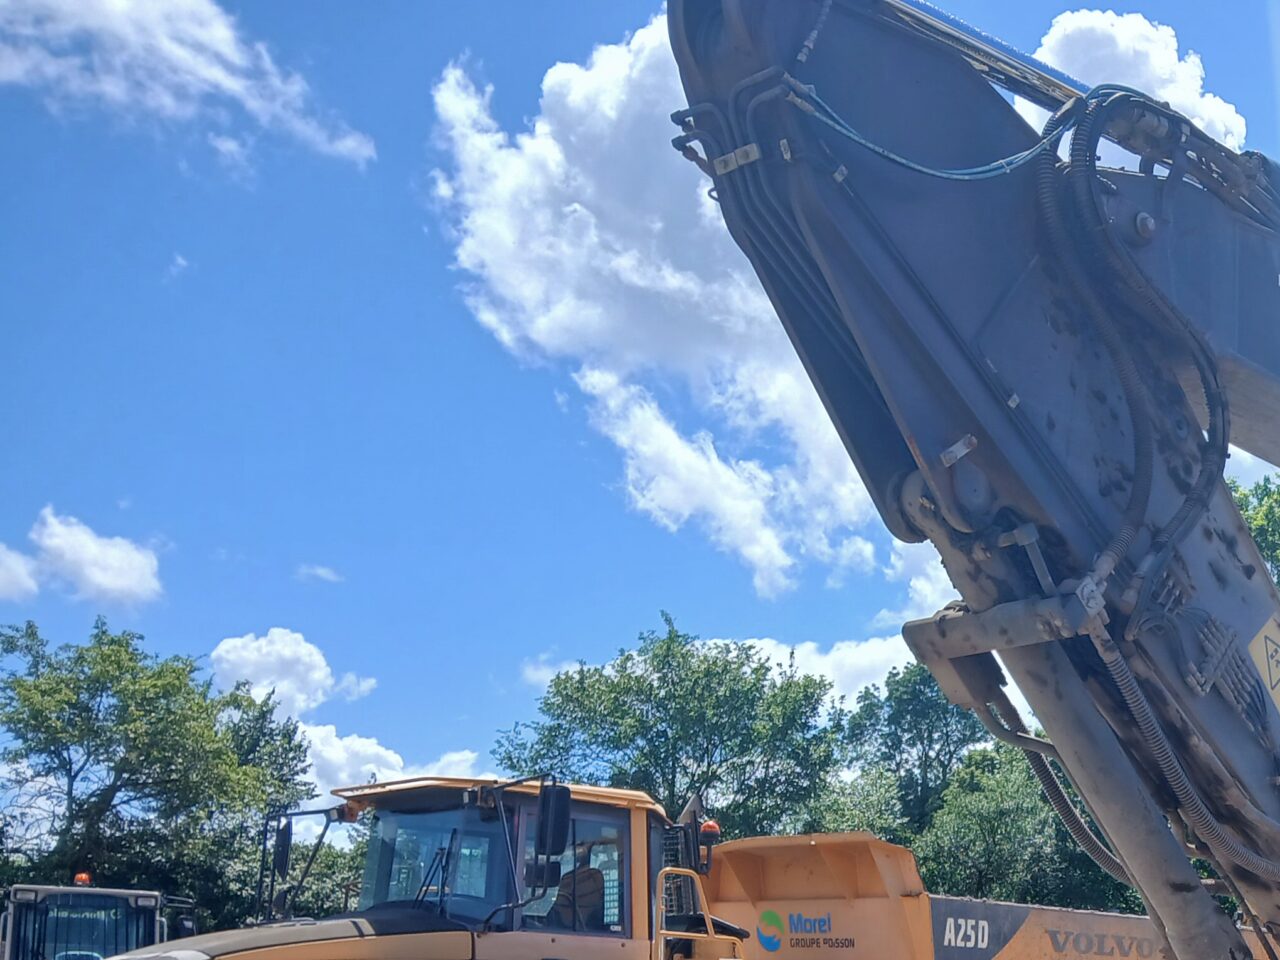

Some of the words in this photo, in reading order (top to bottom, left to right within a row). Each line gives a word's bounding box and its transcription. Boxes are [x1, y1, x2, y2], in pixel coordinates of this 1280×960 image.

[789, 938, 821, 949] GROUPE
[944, 917, 989, 949] A25D
[1046, 929, 1154, 958] VOLVO
